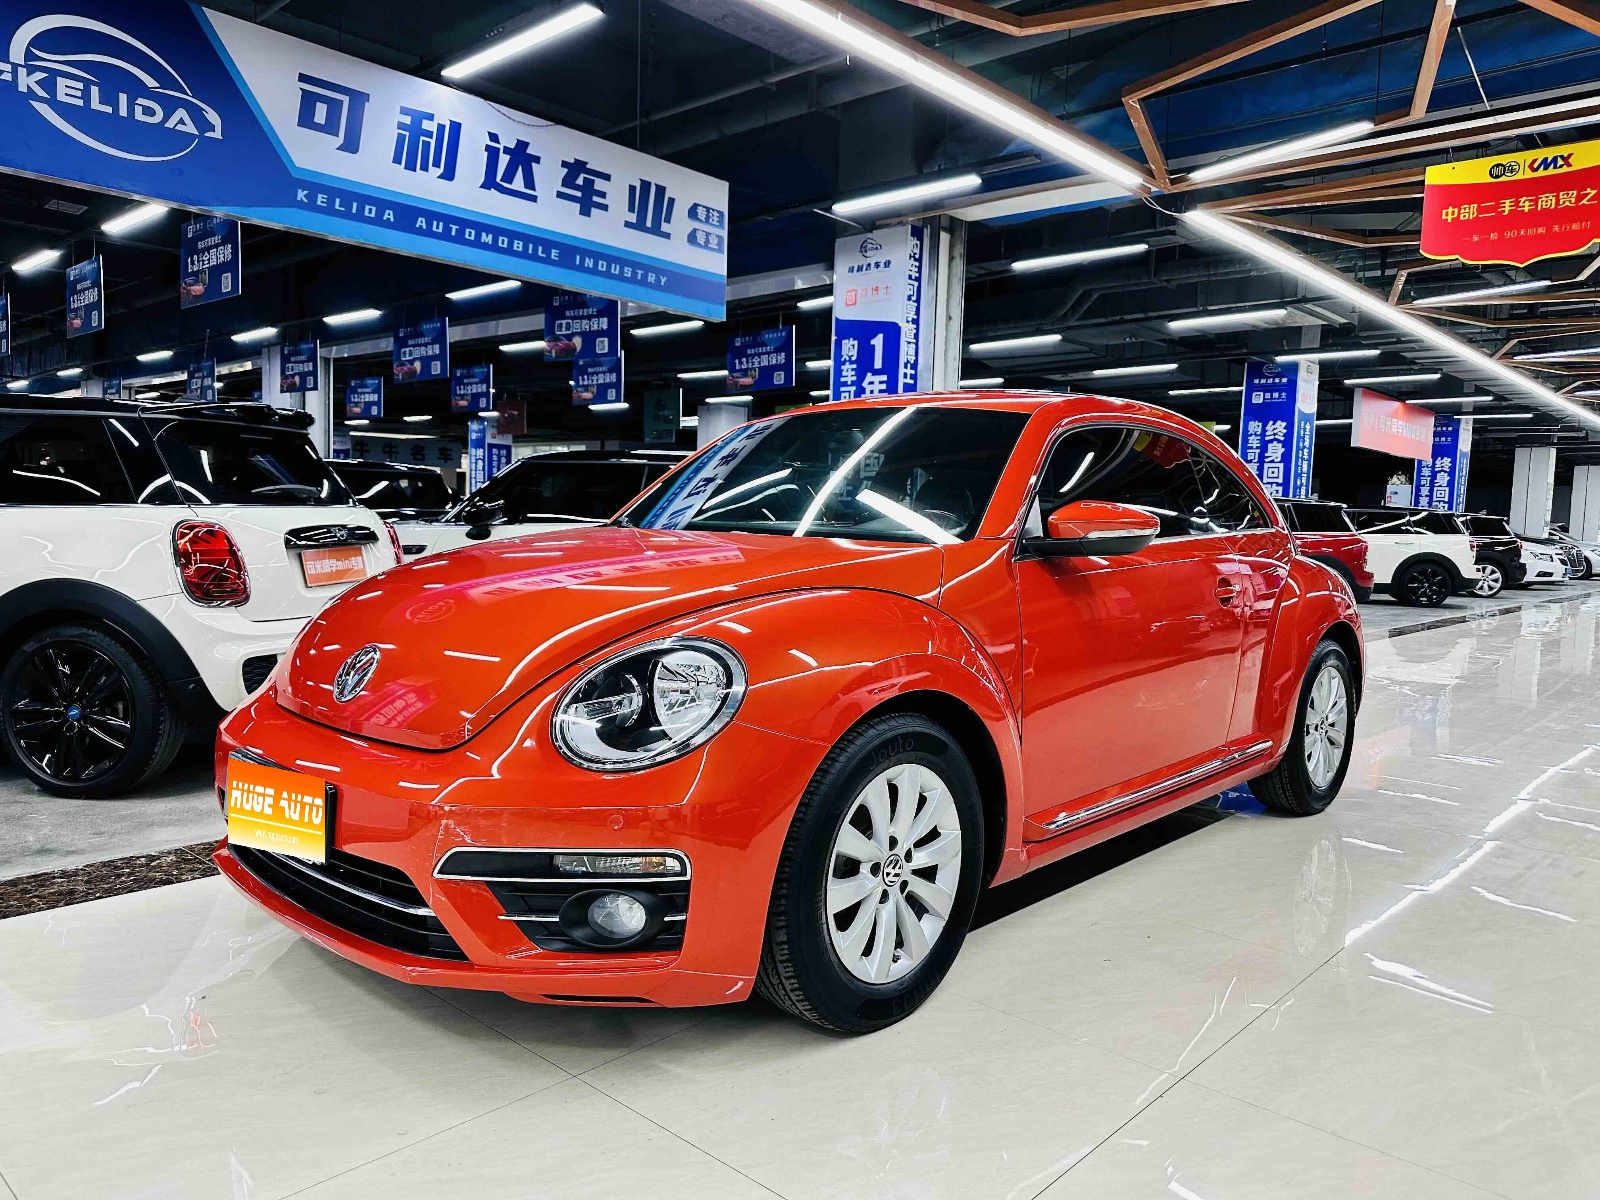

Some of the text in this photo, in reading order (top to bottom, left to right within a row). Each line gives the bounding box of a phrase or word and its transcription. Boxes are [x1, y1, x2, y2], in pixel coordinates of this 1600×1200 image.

[18, 66, 199, 136] KELIDA
[297, 71, 676, 240] 可利达车业
[1528, 153, 1574, 172] KMX
[696, 205, 720, 226] 专注
[1441, 188, 1599, 223] 中部二手车商贸之
[296, 188, 668, 286] KELIDA AUTOMOBILE INDUSTRY
[695, 229, 719, 249] 专业
[1462, 232, 1498, 242] 一车一检
[1504, 226, 1546, 239] 90天回购
[847, 260, 892, 274] 可利达车业
[1263, 420, 1287, 498] 终身回购
